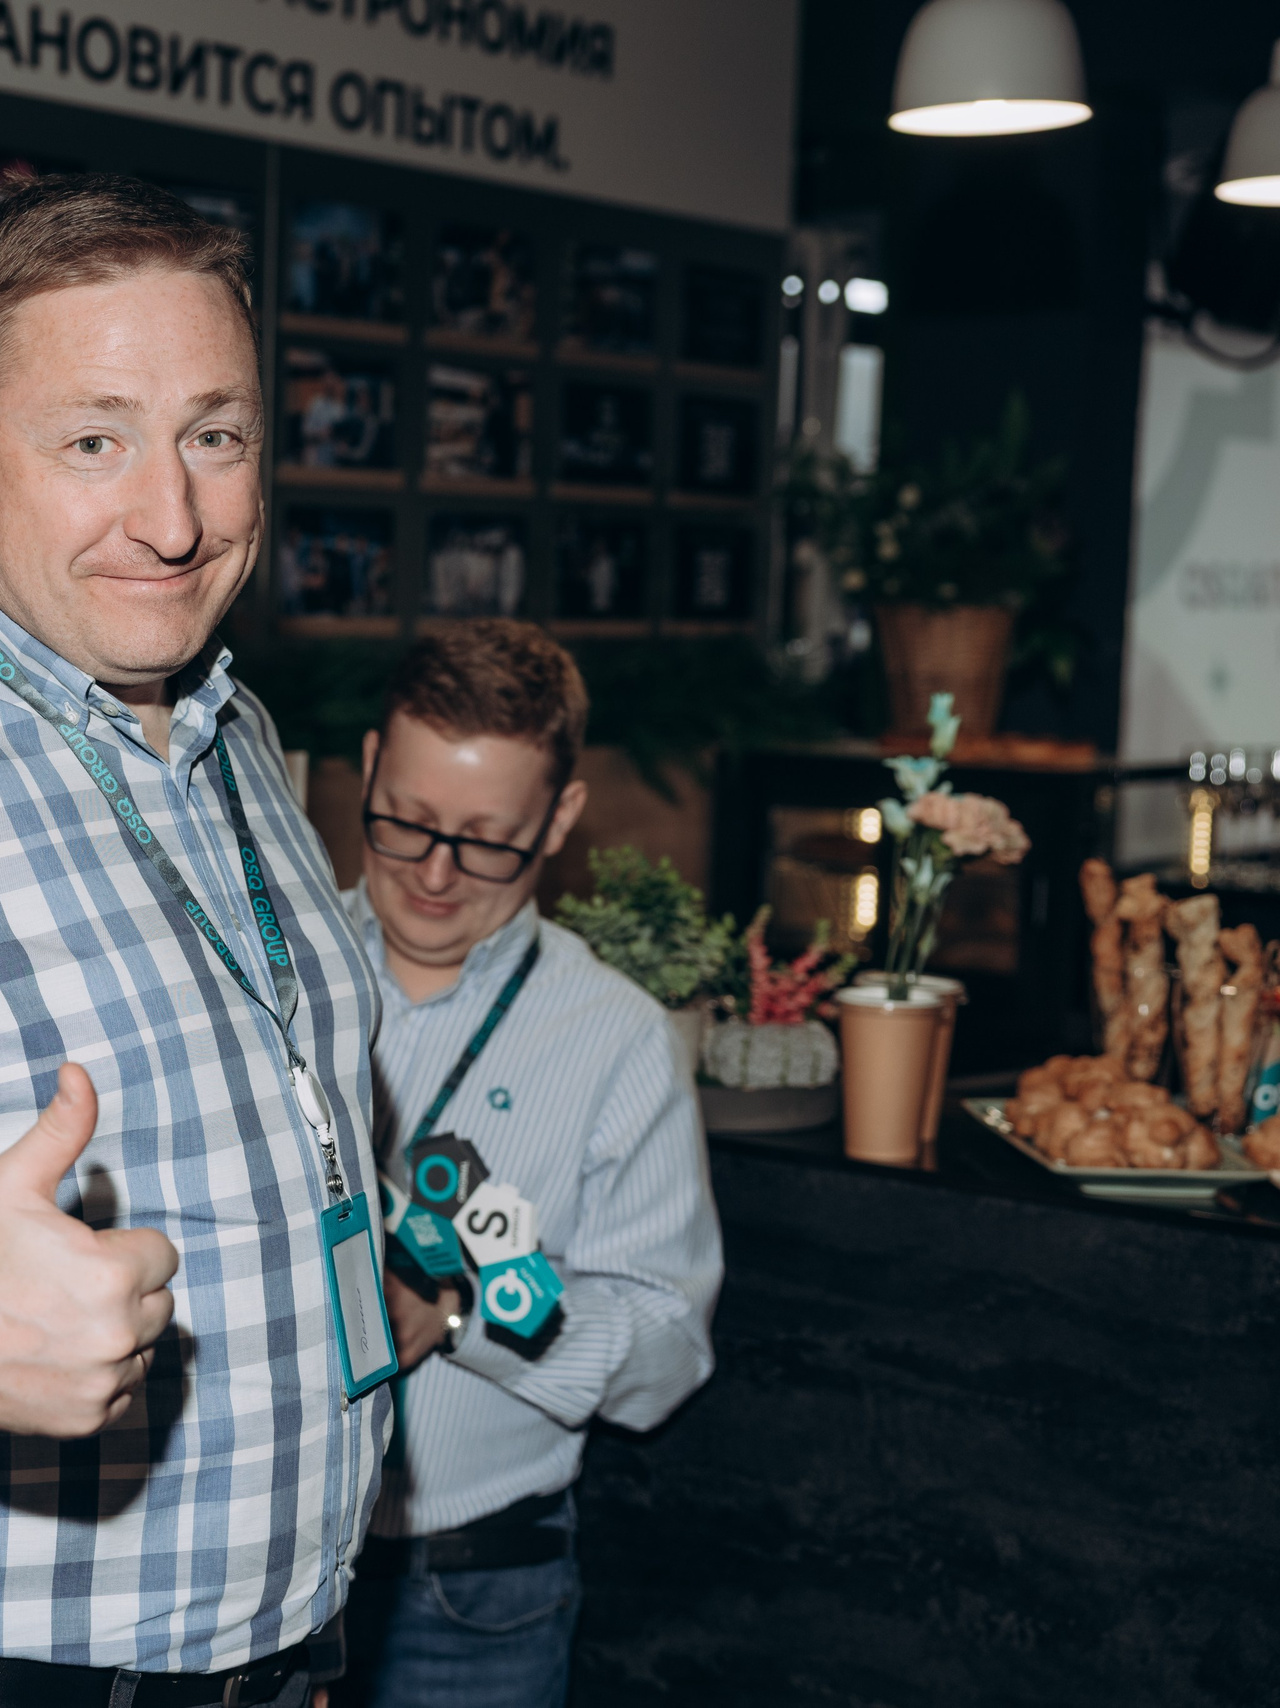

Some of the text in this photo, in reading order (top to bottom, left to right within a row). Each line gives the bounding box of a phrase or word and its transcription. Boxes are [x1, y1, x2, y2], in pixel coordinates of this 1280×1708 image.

[257, 0, 614, 79] ОНОМИЯ
[328, 70, 570, 173] ОПЫТОМ.
[59, 723, 152, 844] OSQ GROUP
[216, 727, 236, 791] ROUP
[241, 847, 289, 967] OSQ GROUP
[467, 1208, 509, 1239] S
